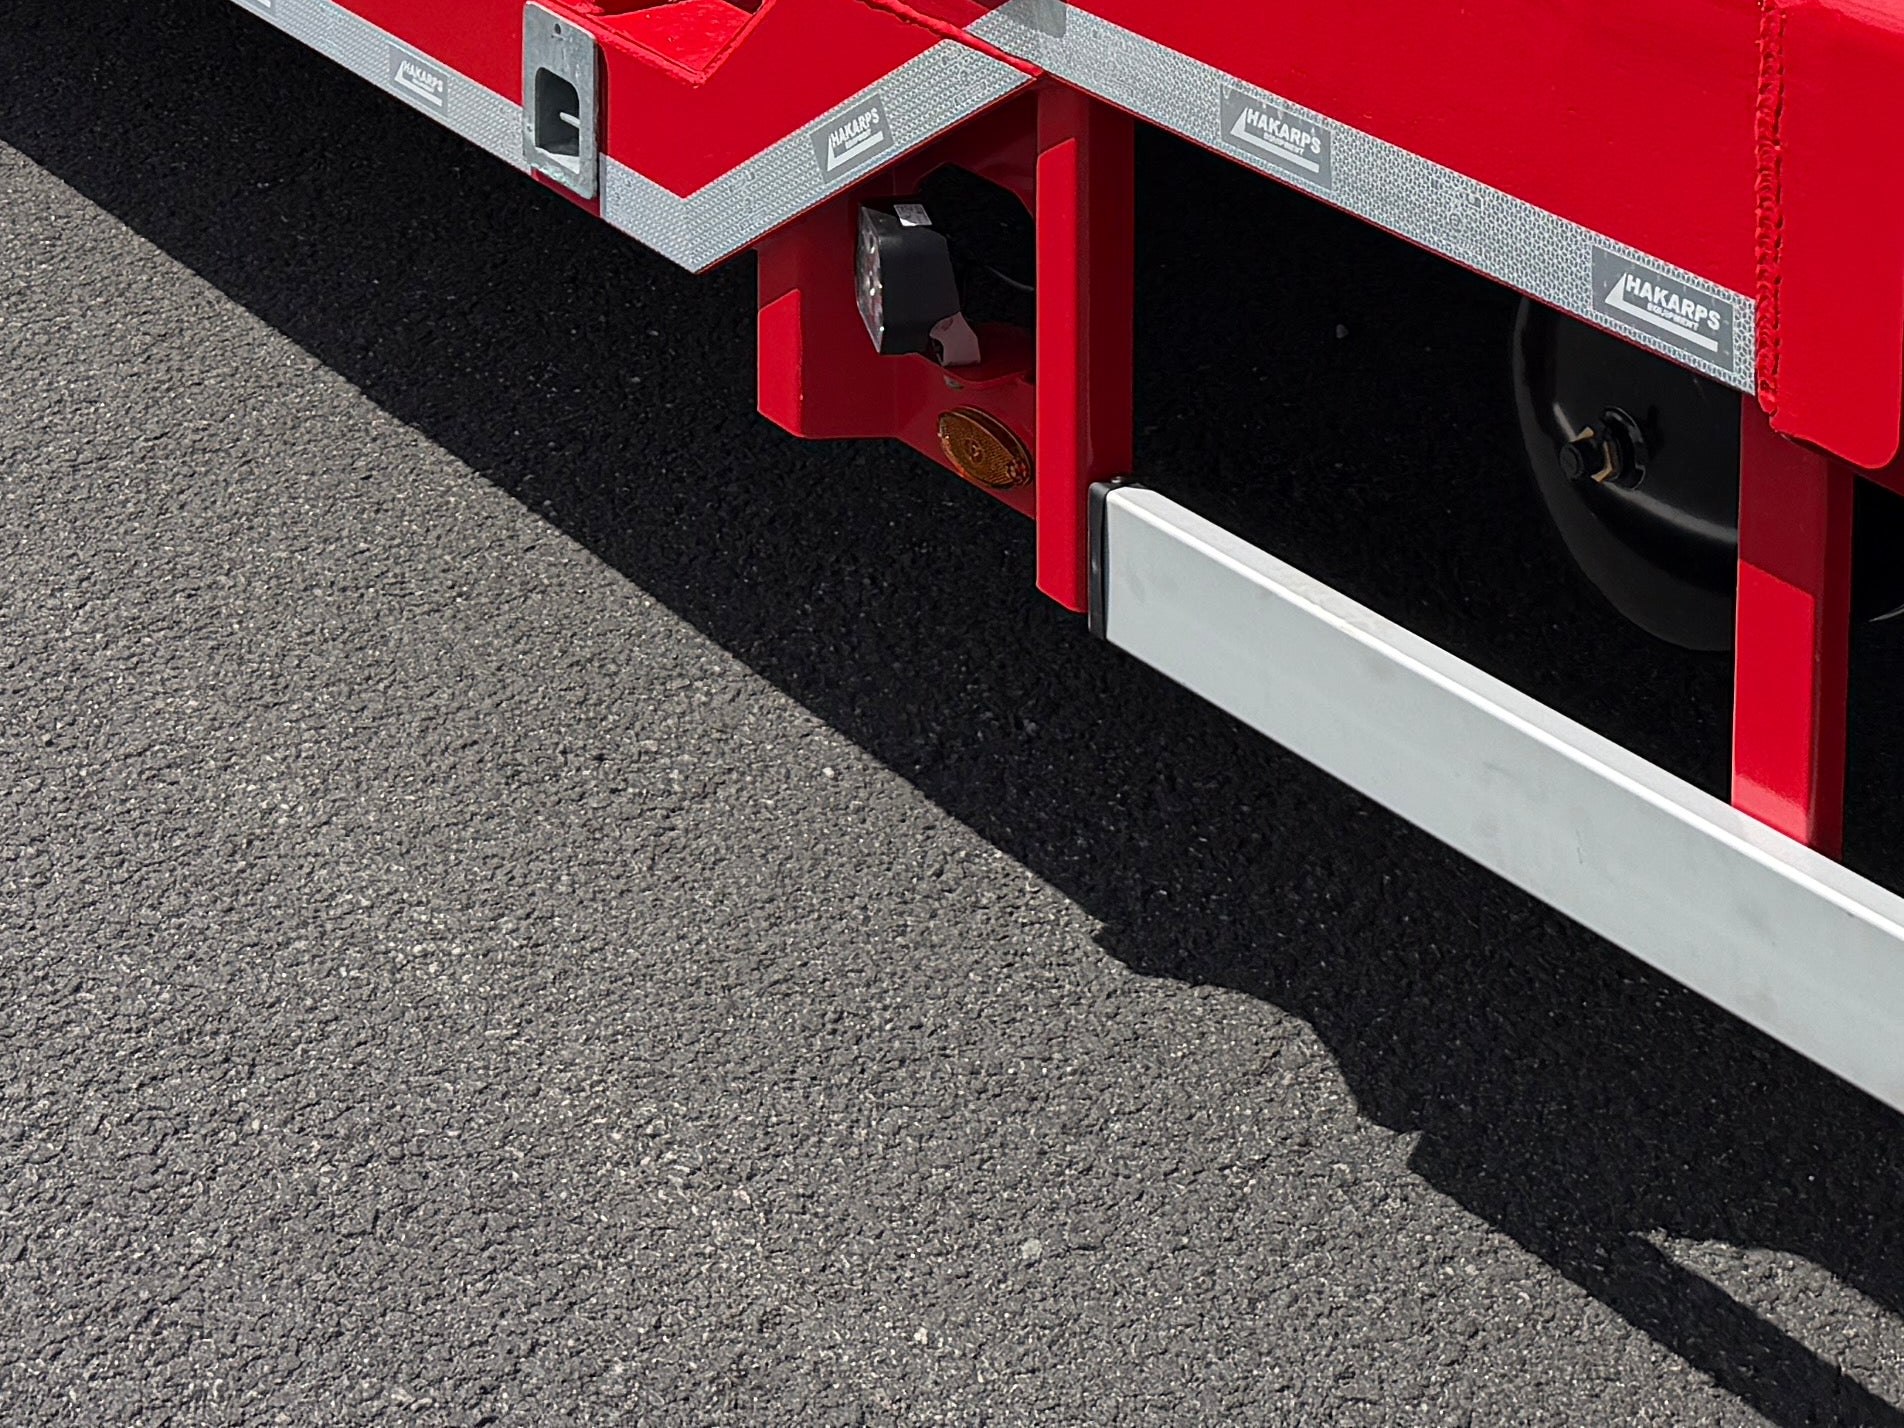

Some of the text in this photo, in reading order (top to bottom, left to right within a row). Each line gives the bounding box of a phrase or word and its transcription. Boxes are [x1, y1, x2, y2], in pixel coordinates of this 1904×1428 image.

[830, 107, 880, 148] HAKARPS
[1246, 108, 1321, 154] HAKARPS
[1625, 274, 1721, 331] HAKARPS
